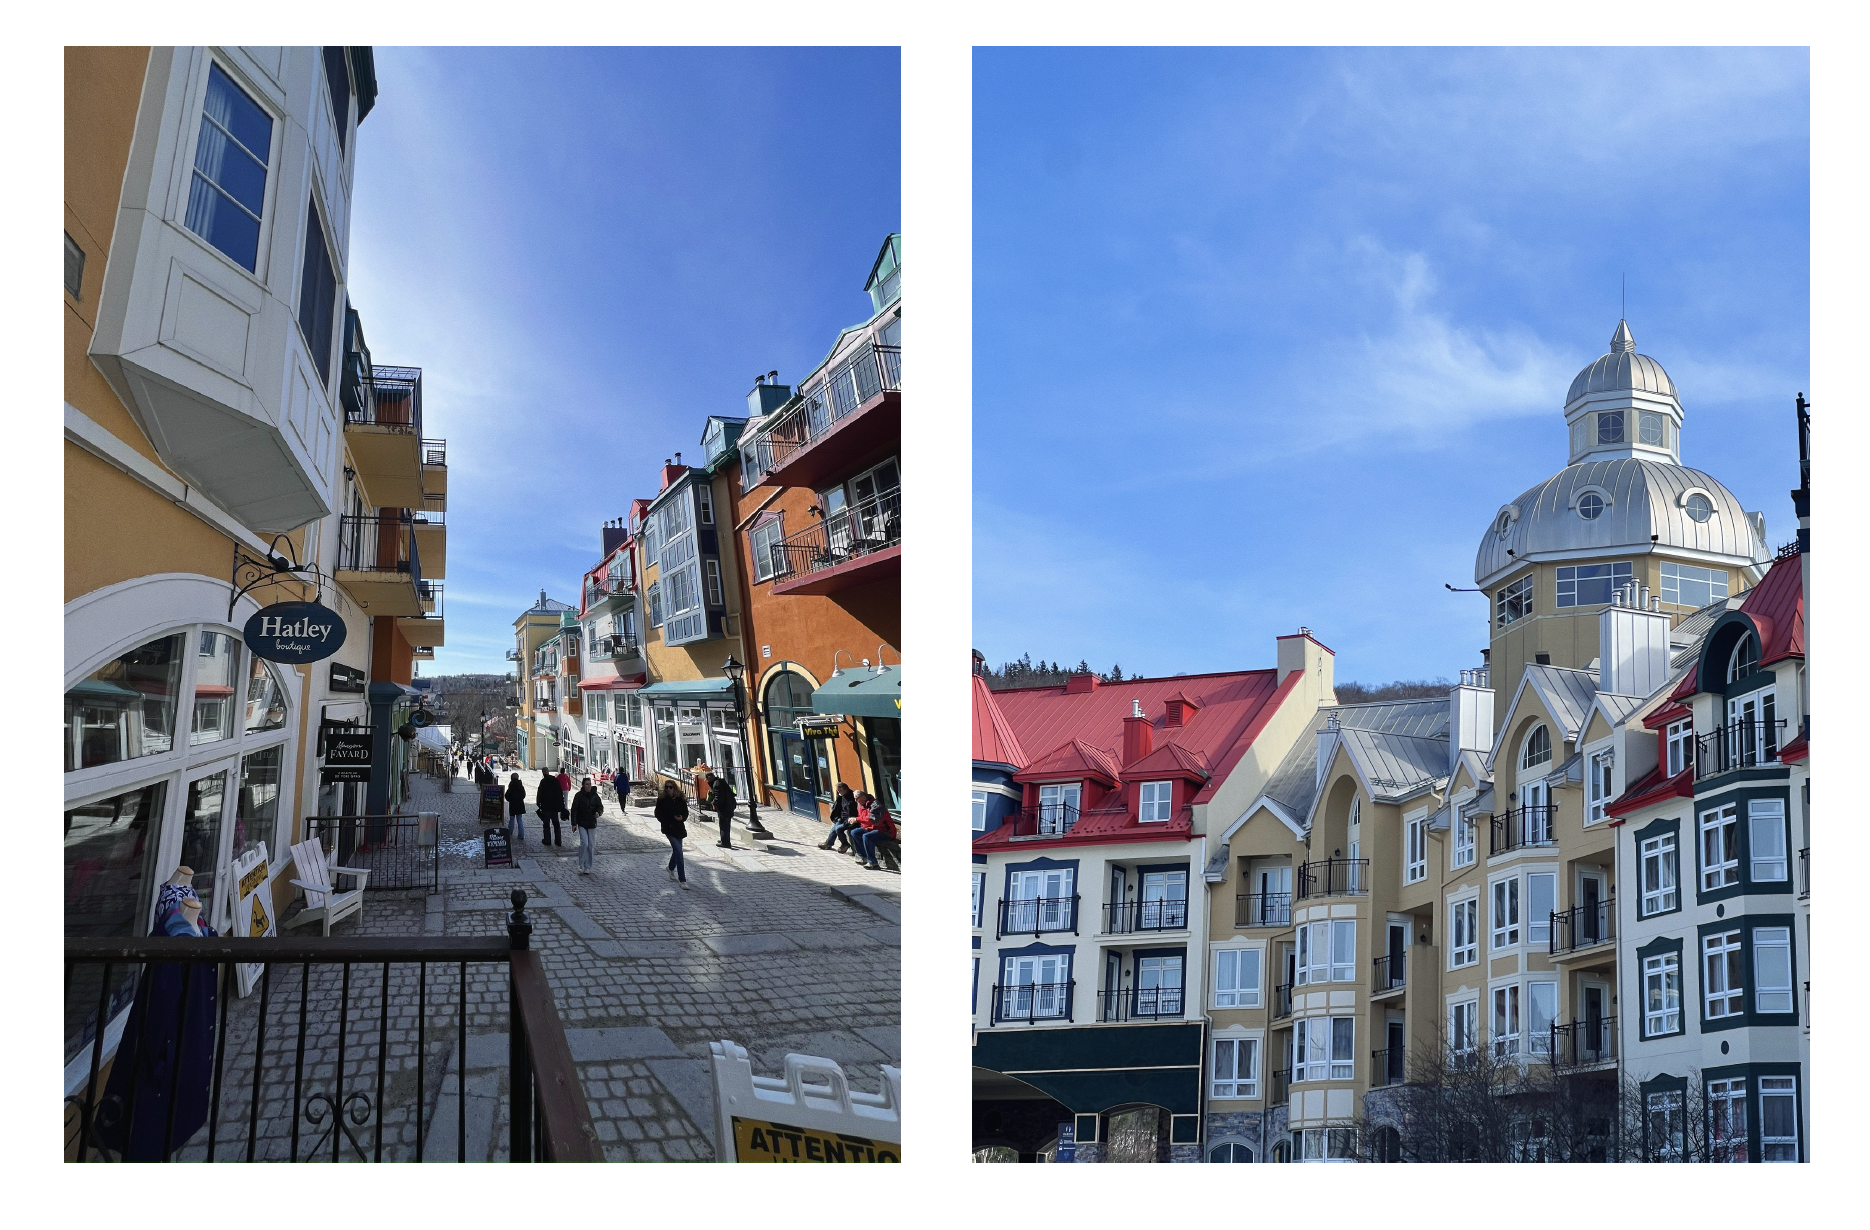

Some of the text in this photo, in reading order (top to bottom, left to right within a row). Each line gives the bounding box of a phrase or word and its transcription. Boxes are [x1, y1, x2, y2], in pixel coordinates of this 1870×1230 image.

[259, 616, 332, 643] Hatley
[276, 639, 311, 655] boutique
[804, 727, 822, 736] Viva
[330, 750, 369, 759] FAYARD
[241, 863, 266, 888] ATTENTION
